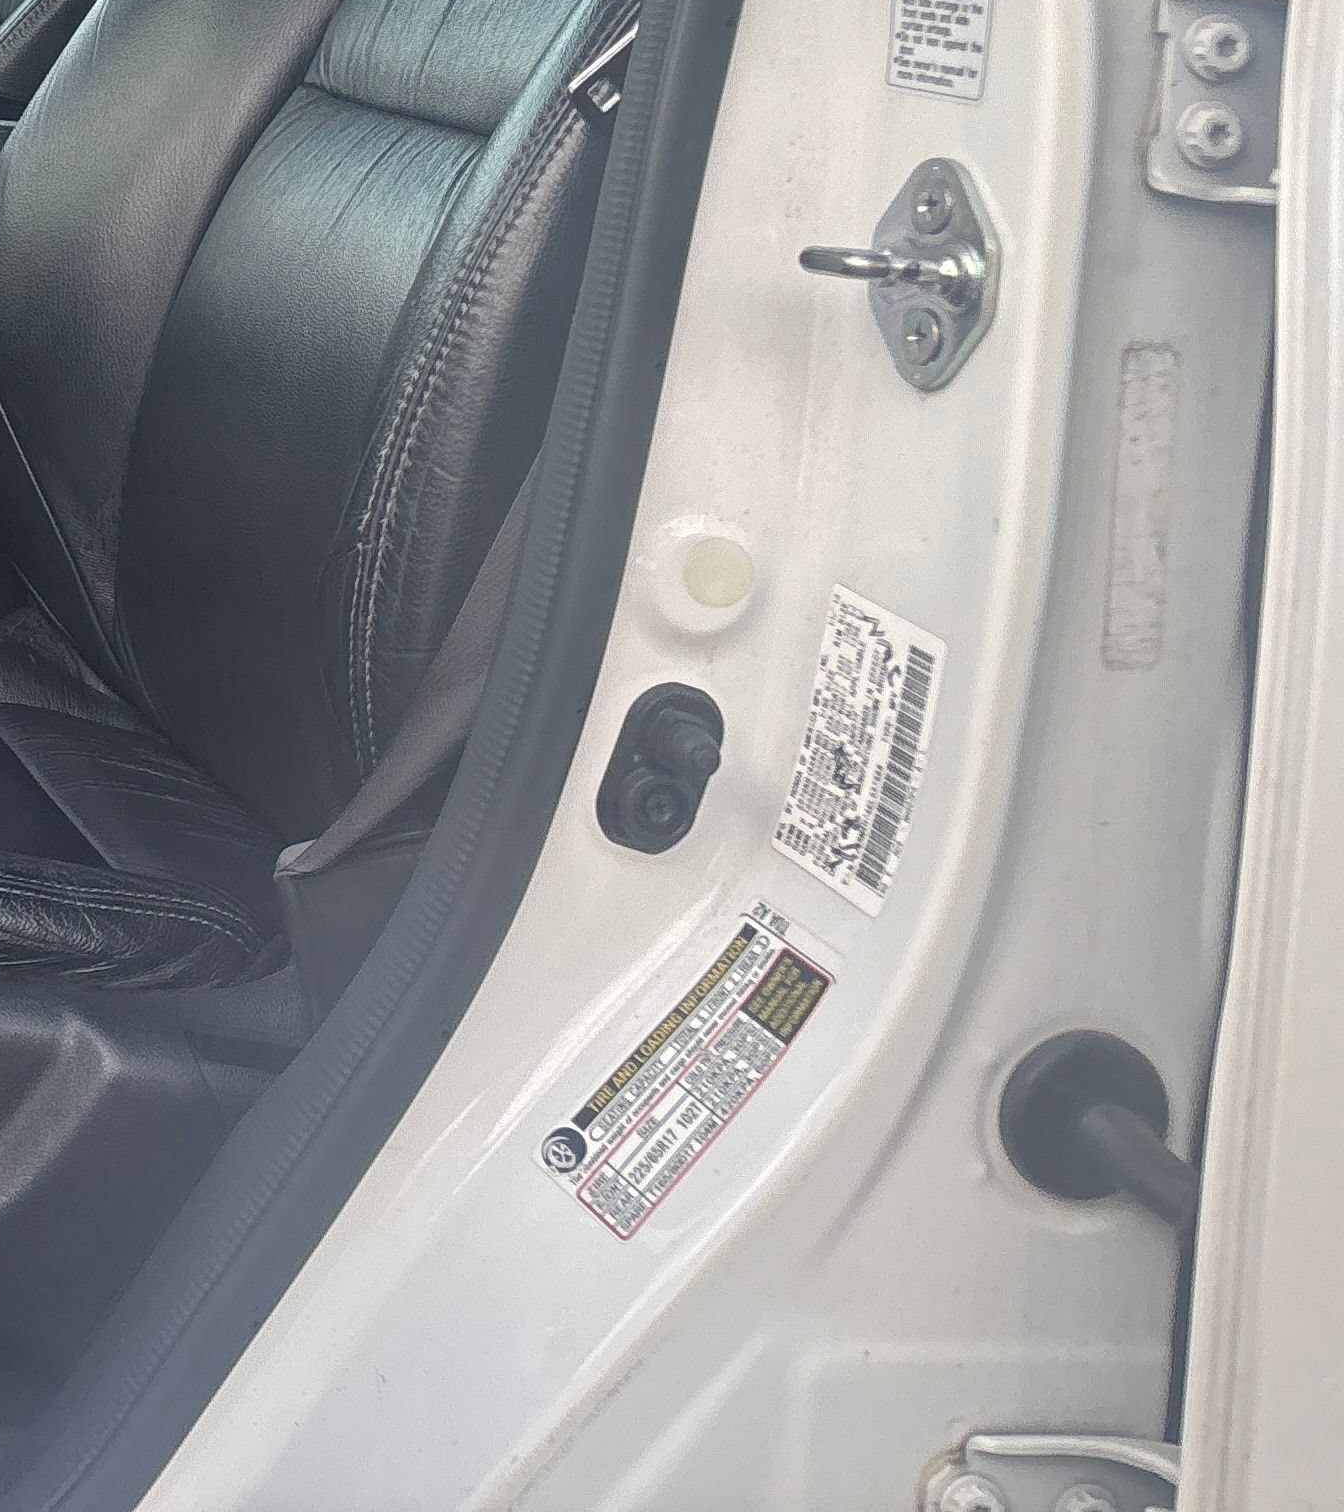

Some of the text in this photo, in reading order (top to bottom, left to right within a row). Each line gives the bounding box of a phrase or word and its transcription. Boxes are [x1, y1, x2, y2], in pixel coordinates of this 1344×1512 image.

[585, 1082, 617, 1115] TIRE
[608, 1057, 639, 1089] AND
[631, 1008, 683, 1064] LOADING
[675, 933, 750, 1015] INFORMATION
[626, 1126, 680, 1185] 225/65R17
[674, 1100, 704, 1131] 102T
